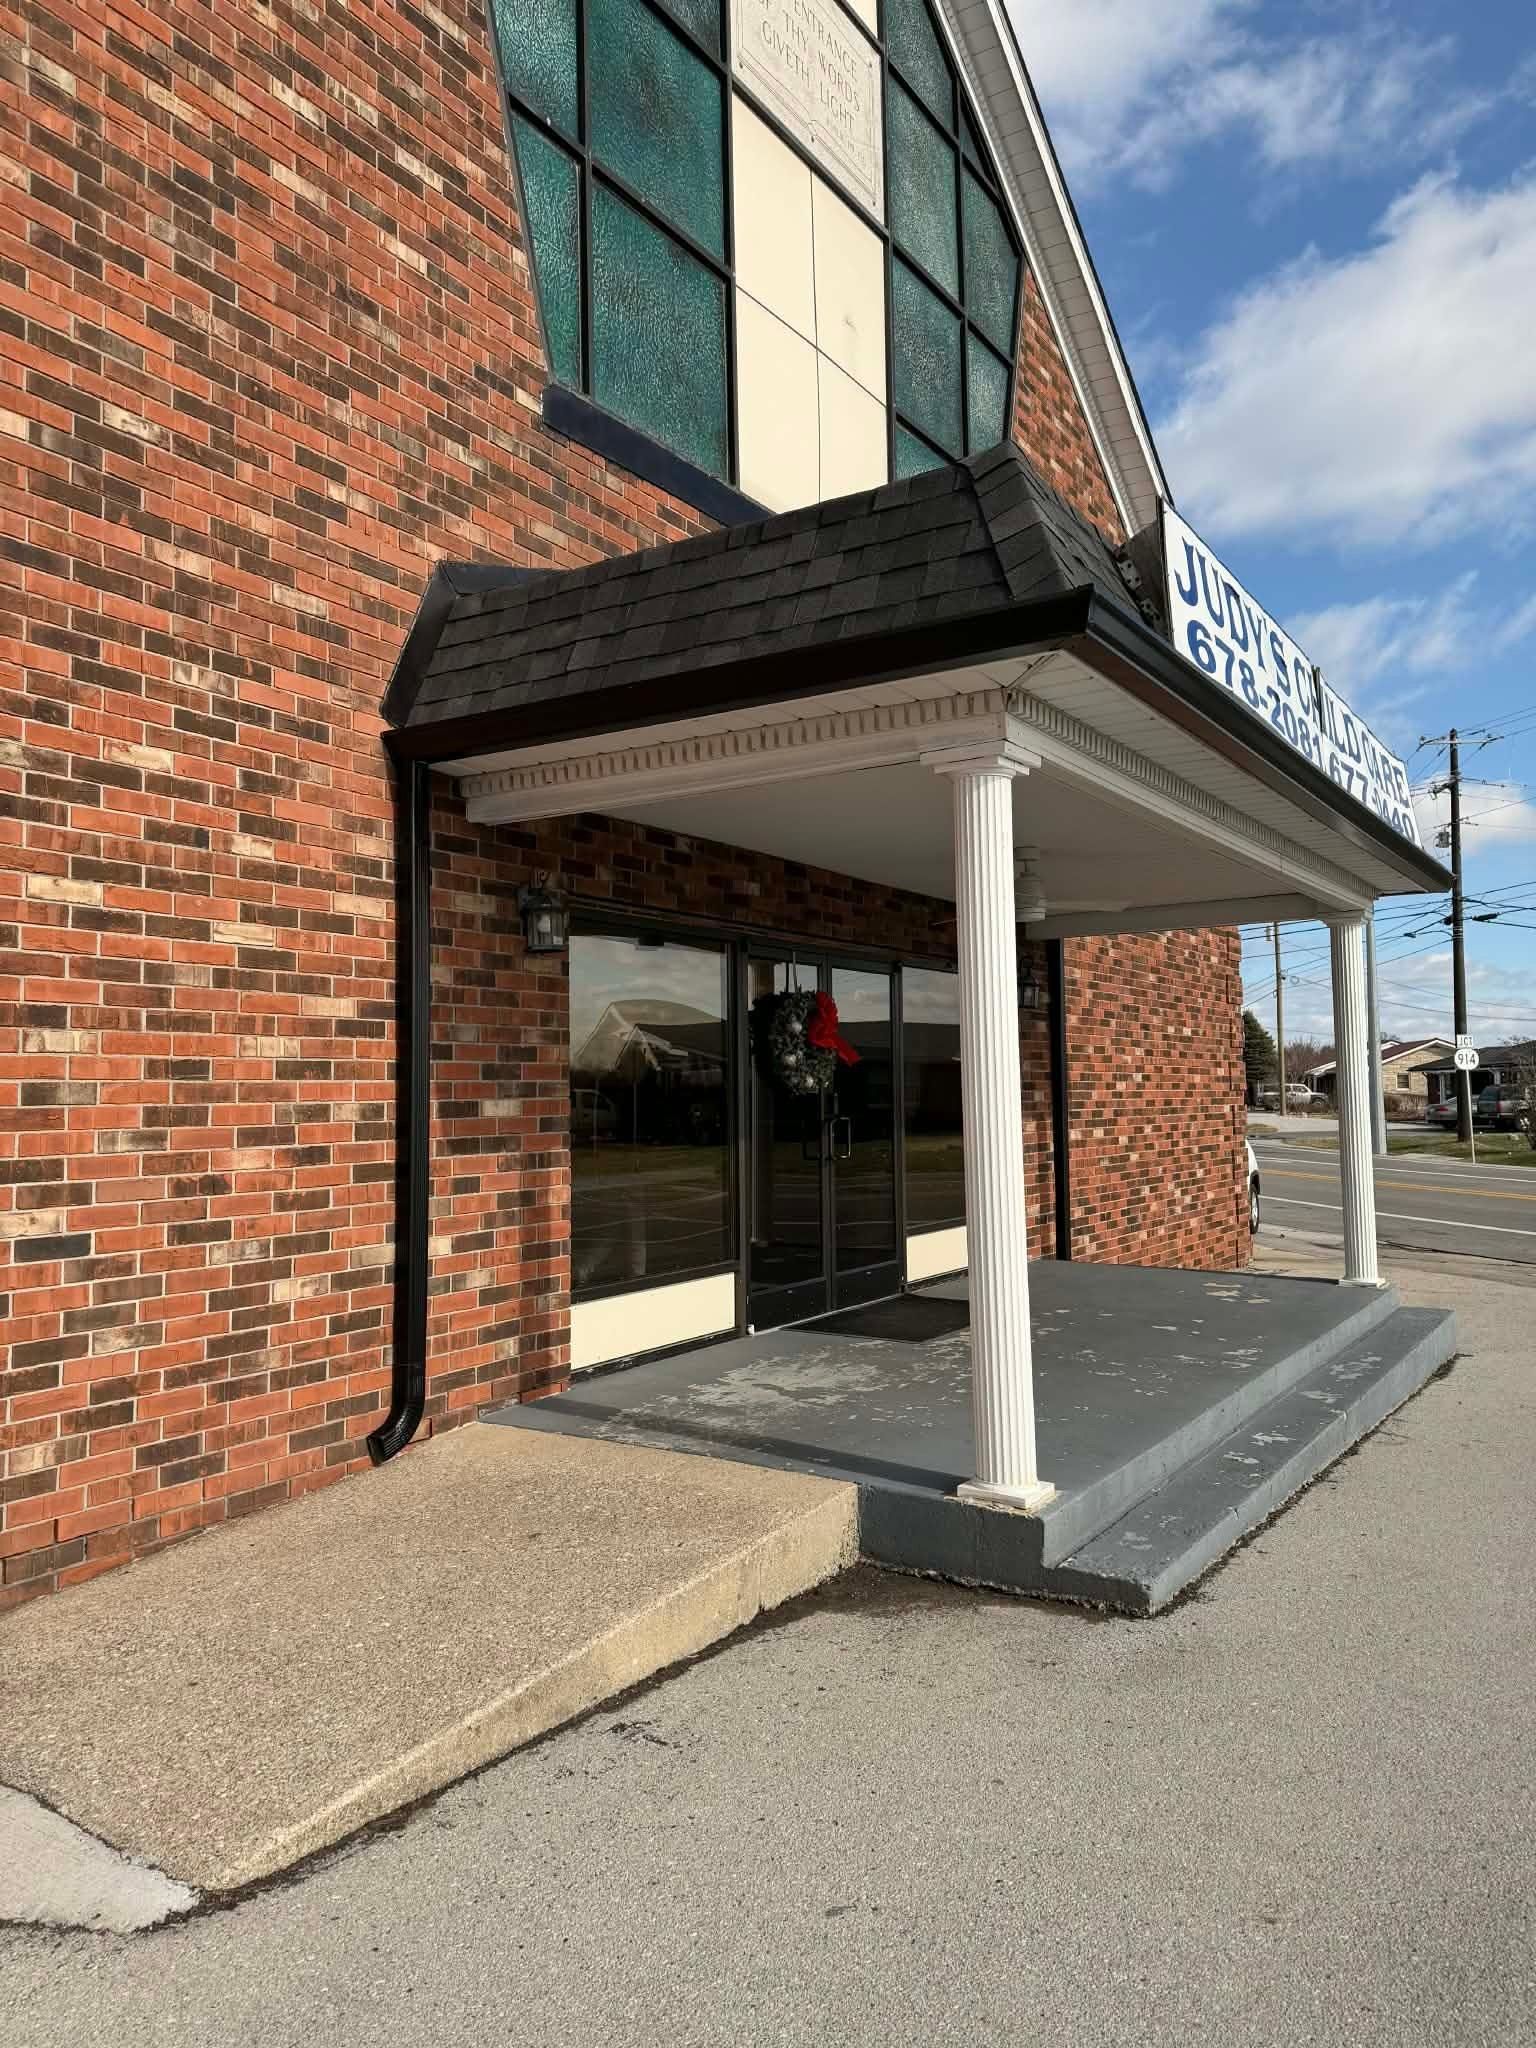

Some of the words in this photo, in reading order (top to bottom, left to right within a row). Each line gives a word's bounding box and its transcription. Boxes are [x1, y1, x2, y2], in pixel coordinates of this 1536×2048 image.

[762, 20, 810, 89] GIVETH
[819, 80, 855, 129] LIGHT
[782, 9, 809, 53] THY
[817, 50, 860, 112] WORDS
[793, 0, 858, 83] ENTRANCE
[1174, 536, 1291, 698] JUDY'S
[1293, 656, 1362, 765] CHILD
[1361, 729, 1411, 809] CARE
[1186, 619, 1325, 772] 678-2081
[1457, 1053, 1476, 1066] 914
